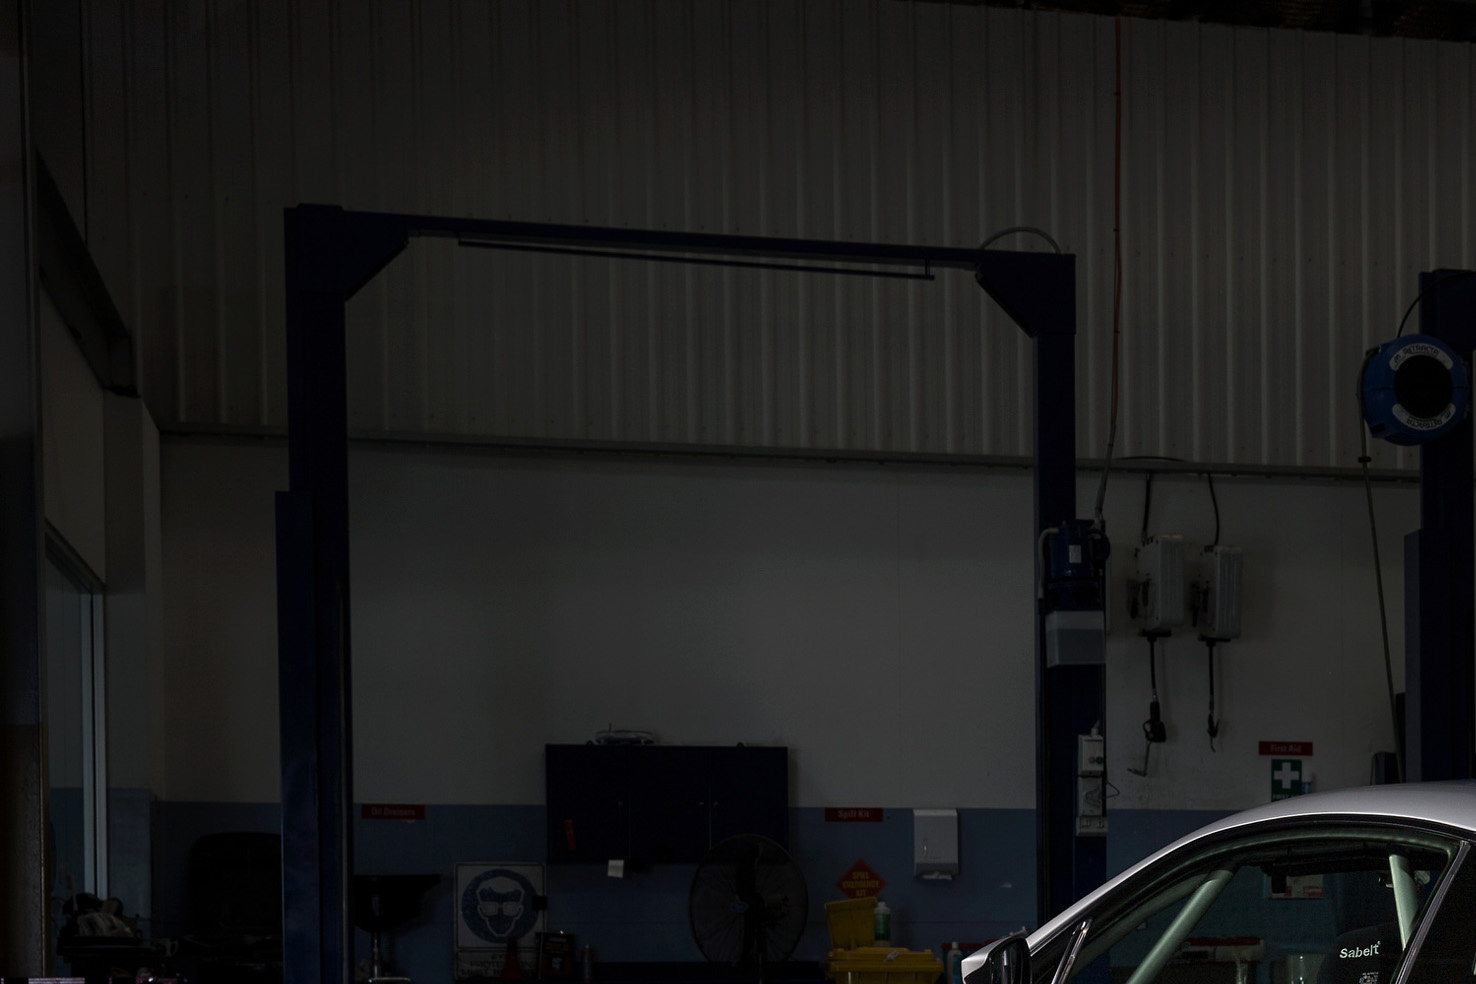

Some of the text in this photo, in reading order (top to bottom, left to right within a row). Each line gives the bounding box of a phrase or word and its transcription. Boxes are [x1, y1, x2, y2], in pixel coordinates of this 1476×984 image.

[837, 809, 870, 820] Spill Kit
[1339, 943, 1380, 959] Sabelt
